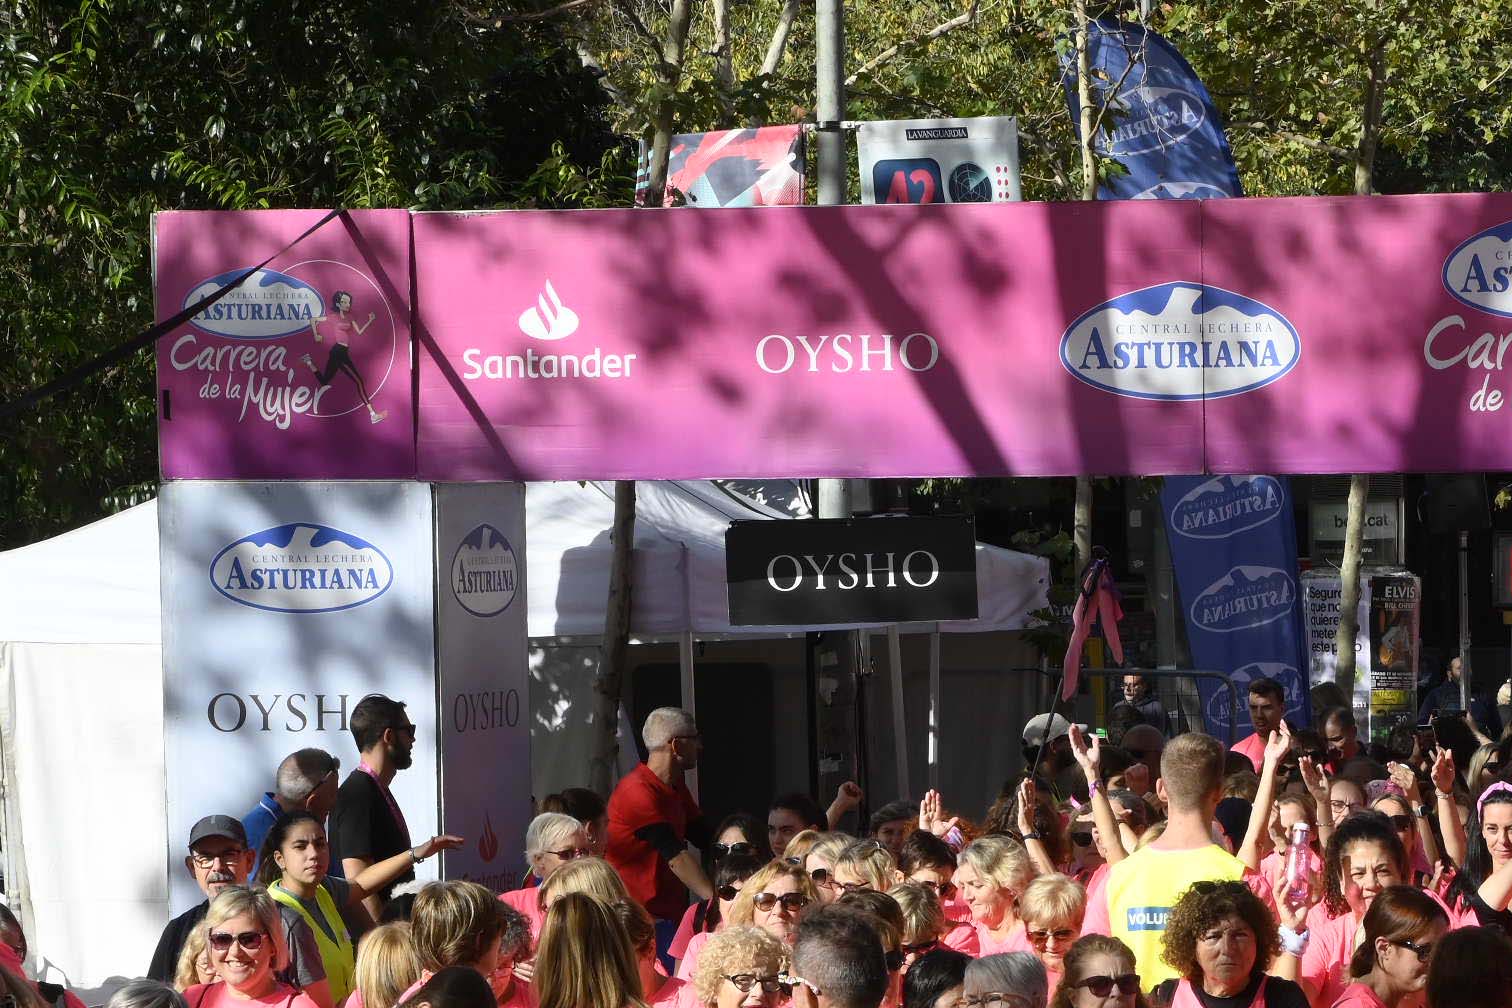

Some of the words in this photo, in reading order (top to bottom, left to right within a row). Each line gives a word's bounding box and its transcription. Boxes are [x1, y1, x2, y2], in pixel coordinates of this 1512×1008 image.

[194, 295, 313, 321] ASTURIANA
[1115, 322, 1192, 334] CENTRAL
[1198, 321, 1274, 334] LECHERA
[170, 334, 288, 371] Carrera
[463, 347, 637, 380] Santander
[756, 333, 939, 373] OYSHO
[1080, 332, 1281, 371] ASTURIANA
[199, 374, 221, 399] de
[225, 371, 241, 399] la
[239, 367, 332, 430] Mujer
[1469, 374, 1504, 412] de
[224, 556, 381, 591] ASTURIANA
[252, 555, 311, 563] CENTRAL
[316, 555, 373, 563] LECHERA
[766, 550, 940, 592] OYSHO
[456, 565, 515, 596] ASTURIANA
[1384, 586, 1416, 599] ELVIS
[1311, 603, 1328, 615] que
[1311, 615, 1342, 628] quiere
[1312, 643, 1330, 653] este
[207, 693, 391, 733] OYSH
[454, 689, 520, 733] OYSHO
